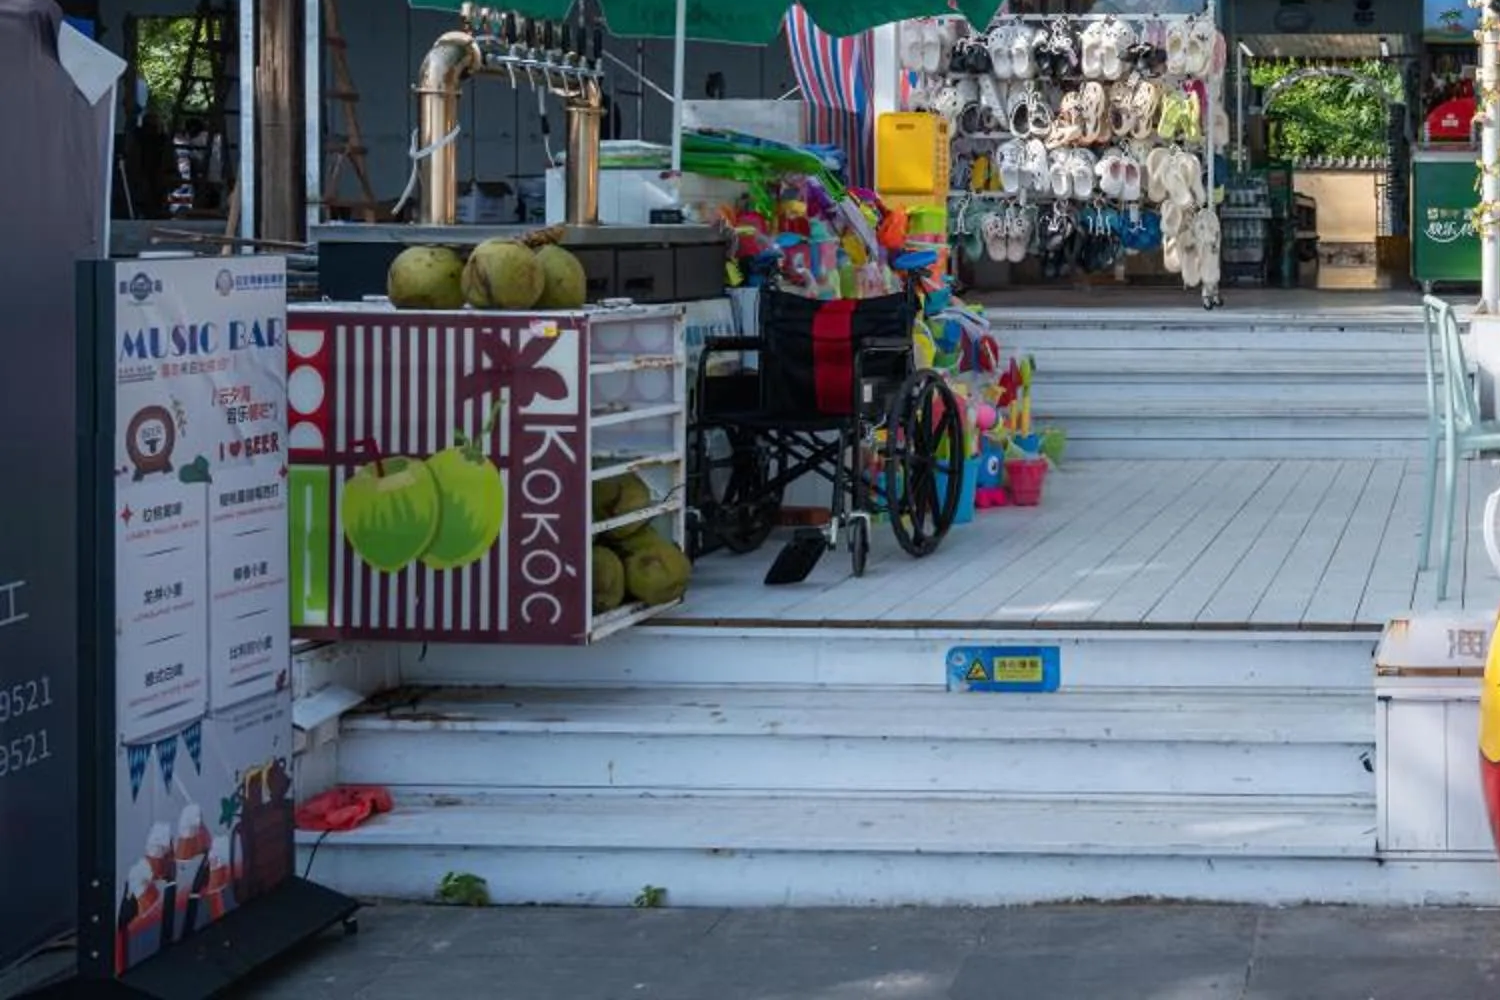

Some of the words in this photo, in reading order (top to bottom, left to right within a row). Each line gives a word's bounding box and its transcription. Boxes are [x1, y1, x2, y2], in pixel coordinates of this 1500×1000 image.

[119, 322, 218, 362] MUSIC
[229, 318, 283, 351] BAR
[245, 432, 279, 458] BEER
